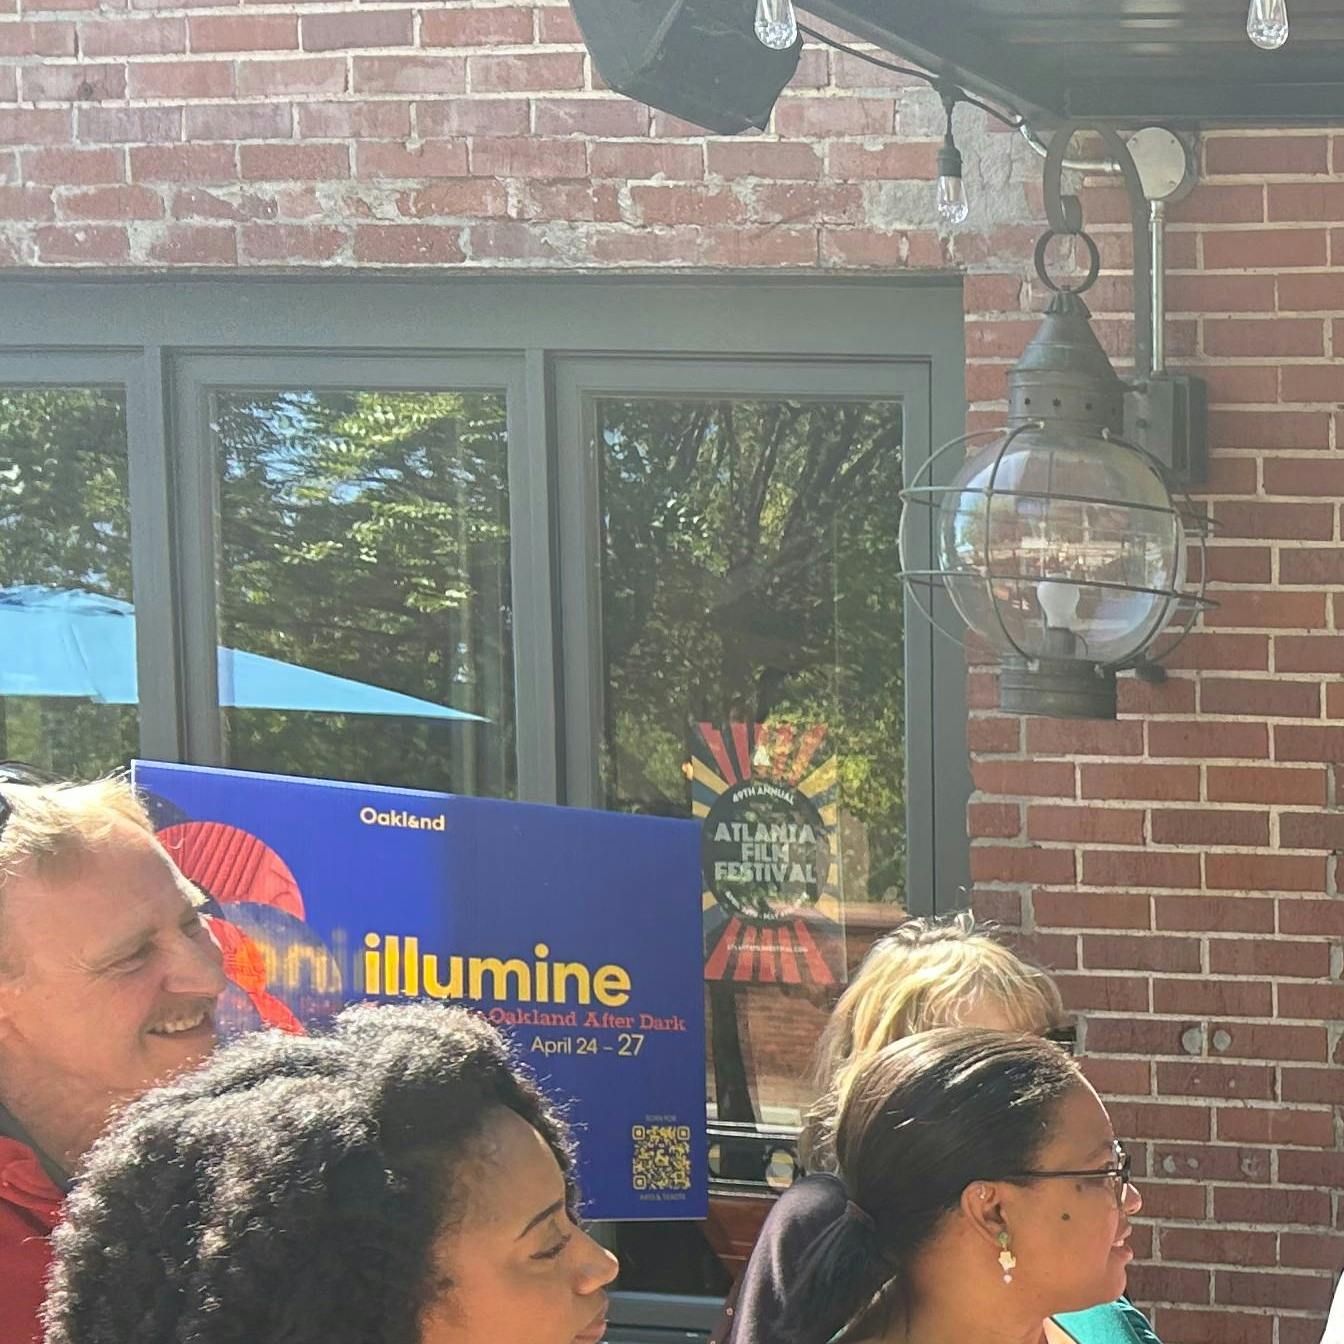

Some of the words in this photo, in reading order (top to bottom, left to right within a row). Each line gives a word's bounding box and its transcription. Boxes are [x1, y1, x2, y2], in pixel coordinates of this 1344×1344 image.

[757, 785, 795, 806] ANNUAL
[714, 821, 816, 844] ATLANTA
[741, 842, 790, 863] FILM
[715, 861, 817, 883] FESTIVAL
[363, 932, 632, 1007] illumine
[488, 1007, 577, 1027] Oakland
[583, 1011, 635, 1028] After
[639, 1013, 687, 1031] Dark
[531, 1036, 571, 1056] April
[576, 1038, 598, 1054] 24
[617, 1034, 644, 1056] 27
